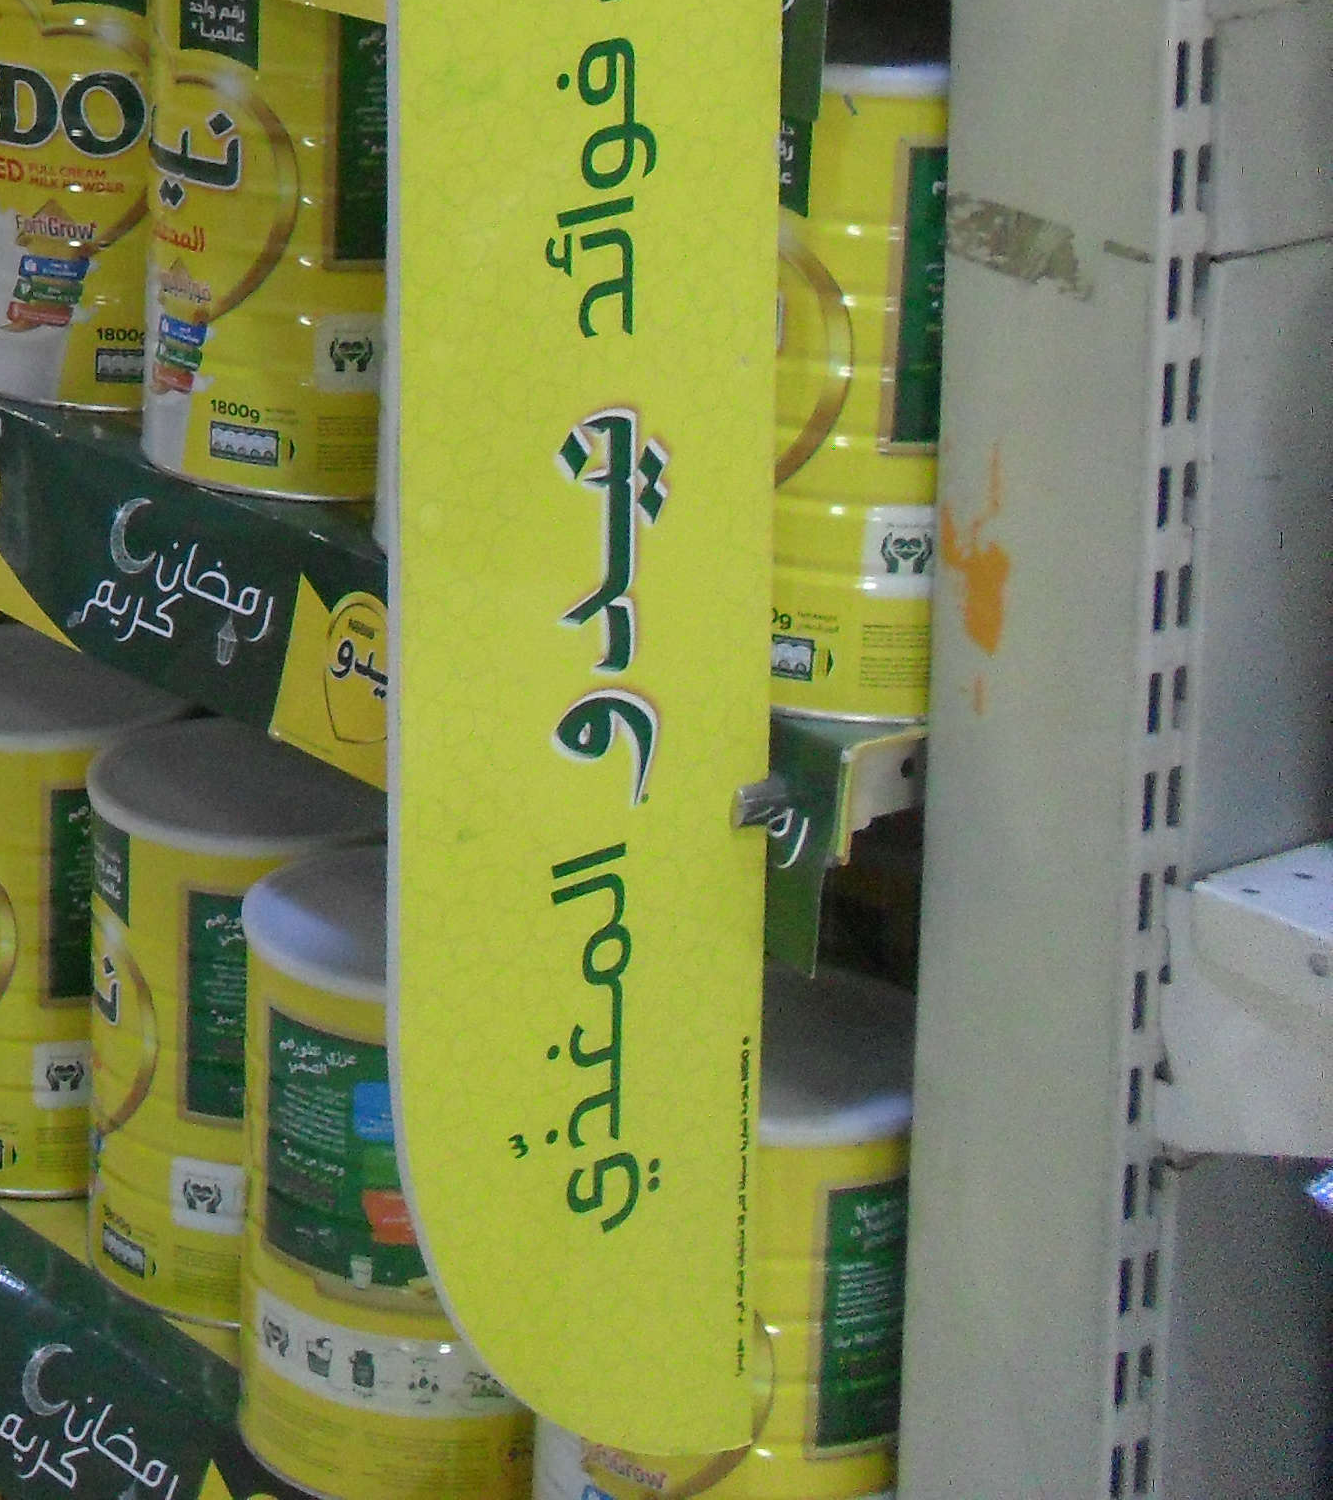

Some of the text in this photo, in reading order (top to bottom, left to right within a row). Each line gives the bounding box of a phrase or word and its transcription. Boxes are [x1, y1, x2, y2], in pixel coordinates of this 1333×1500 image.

[53, 178, 124, 194] POWDER
[58, 166, 106, 179] CREAM
[546, 37, 656, 338] فوائد
[209, 398, 260, 424] 1800g
[80, 579, 184, 643] كريم
[154, 539, 274, 643] رمضان
[556, 408, 668, 803] نيدو
